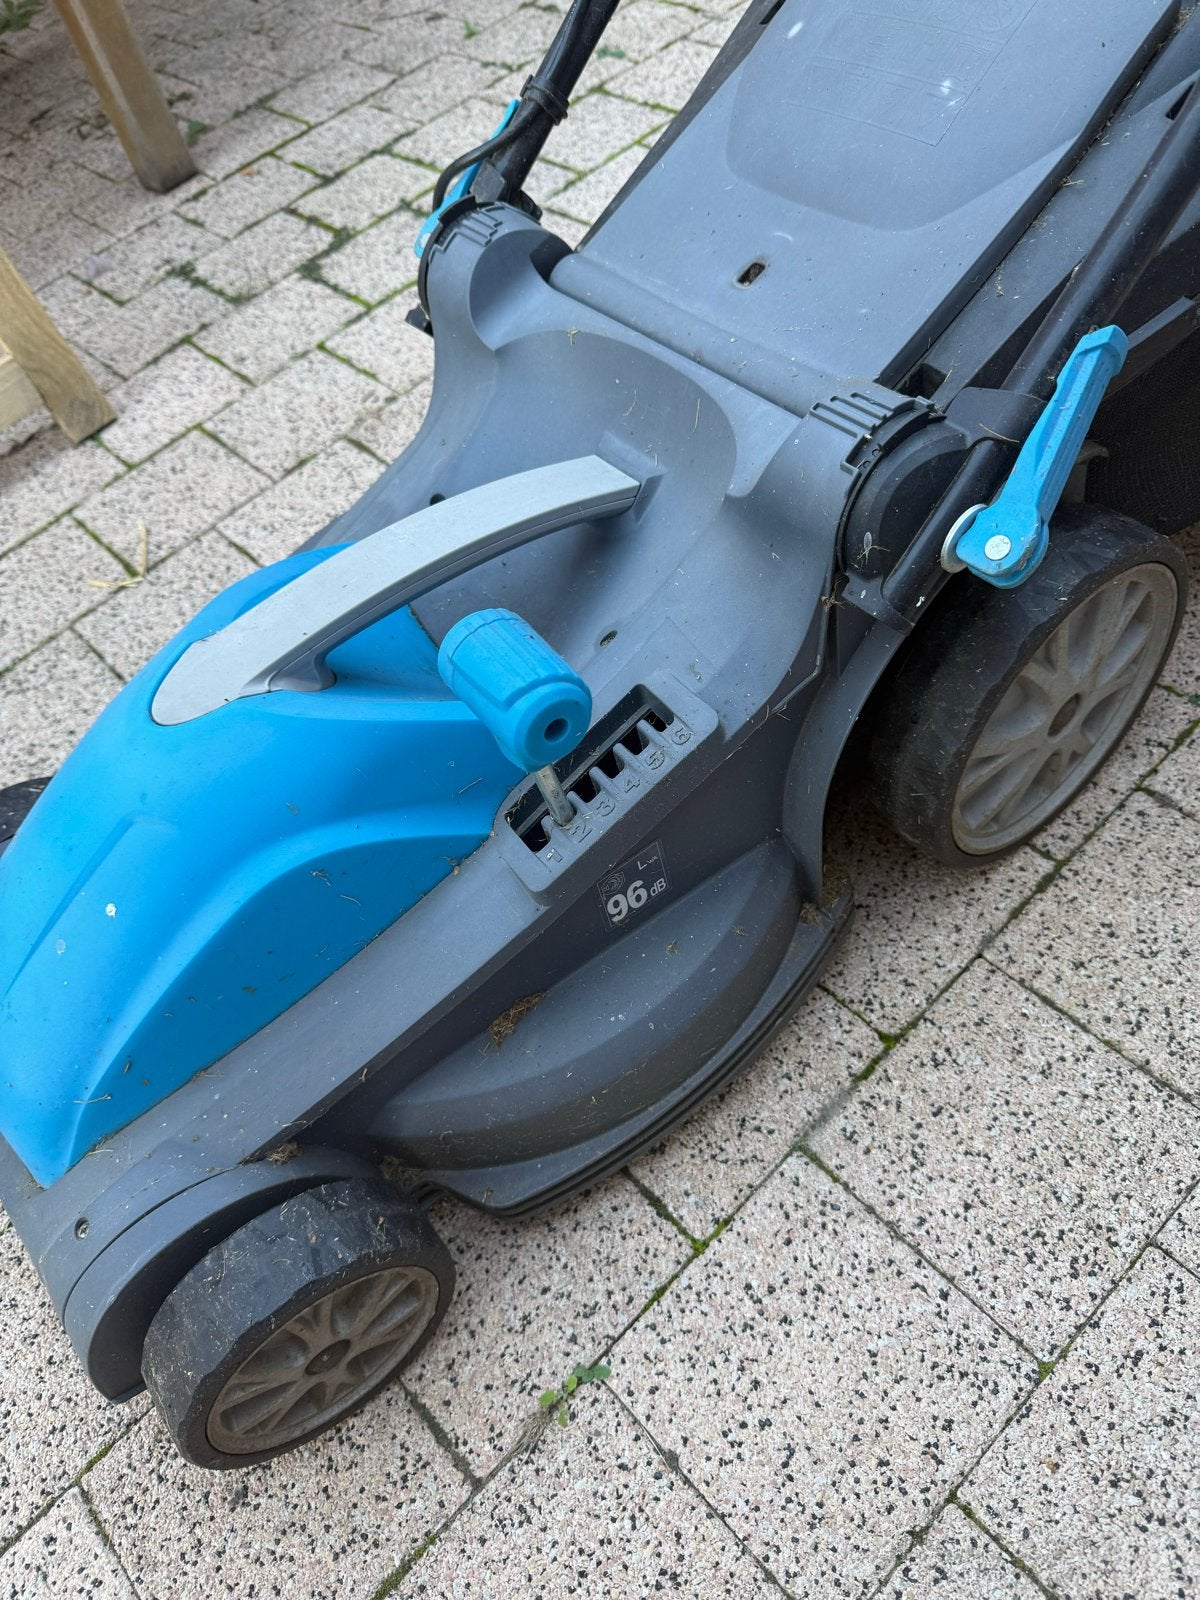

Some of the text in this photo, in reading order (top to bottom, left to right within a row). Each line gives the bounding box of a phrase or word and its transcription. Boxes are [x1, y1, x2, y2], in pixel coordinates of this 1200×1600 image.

[545, 724, 695, 864] 1 2 3 4 5 6
[606, 877, 667, 922] 96 dB
